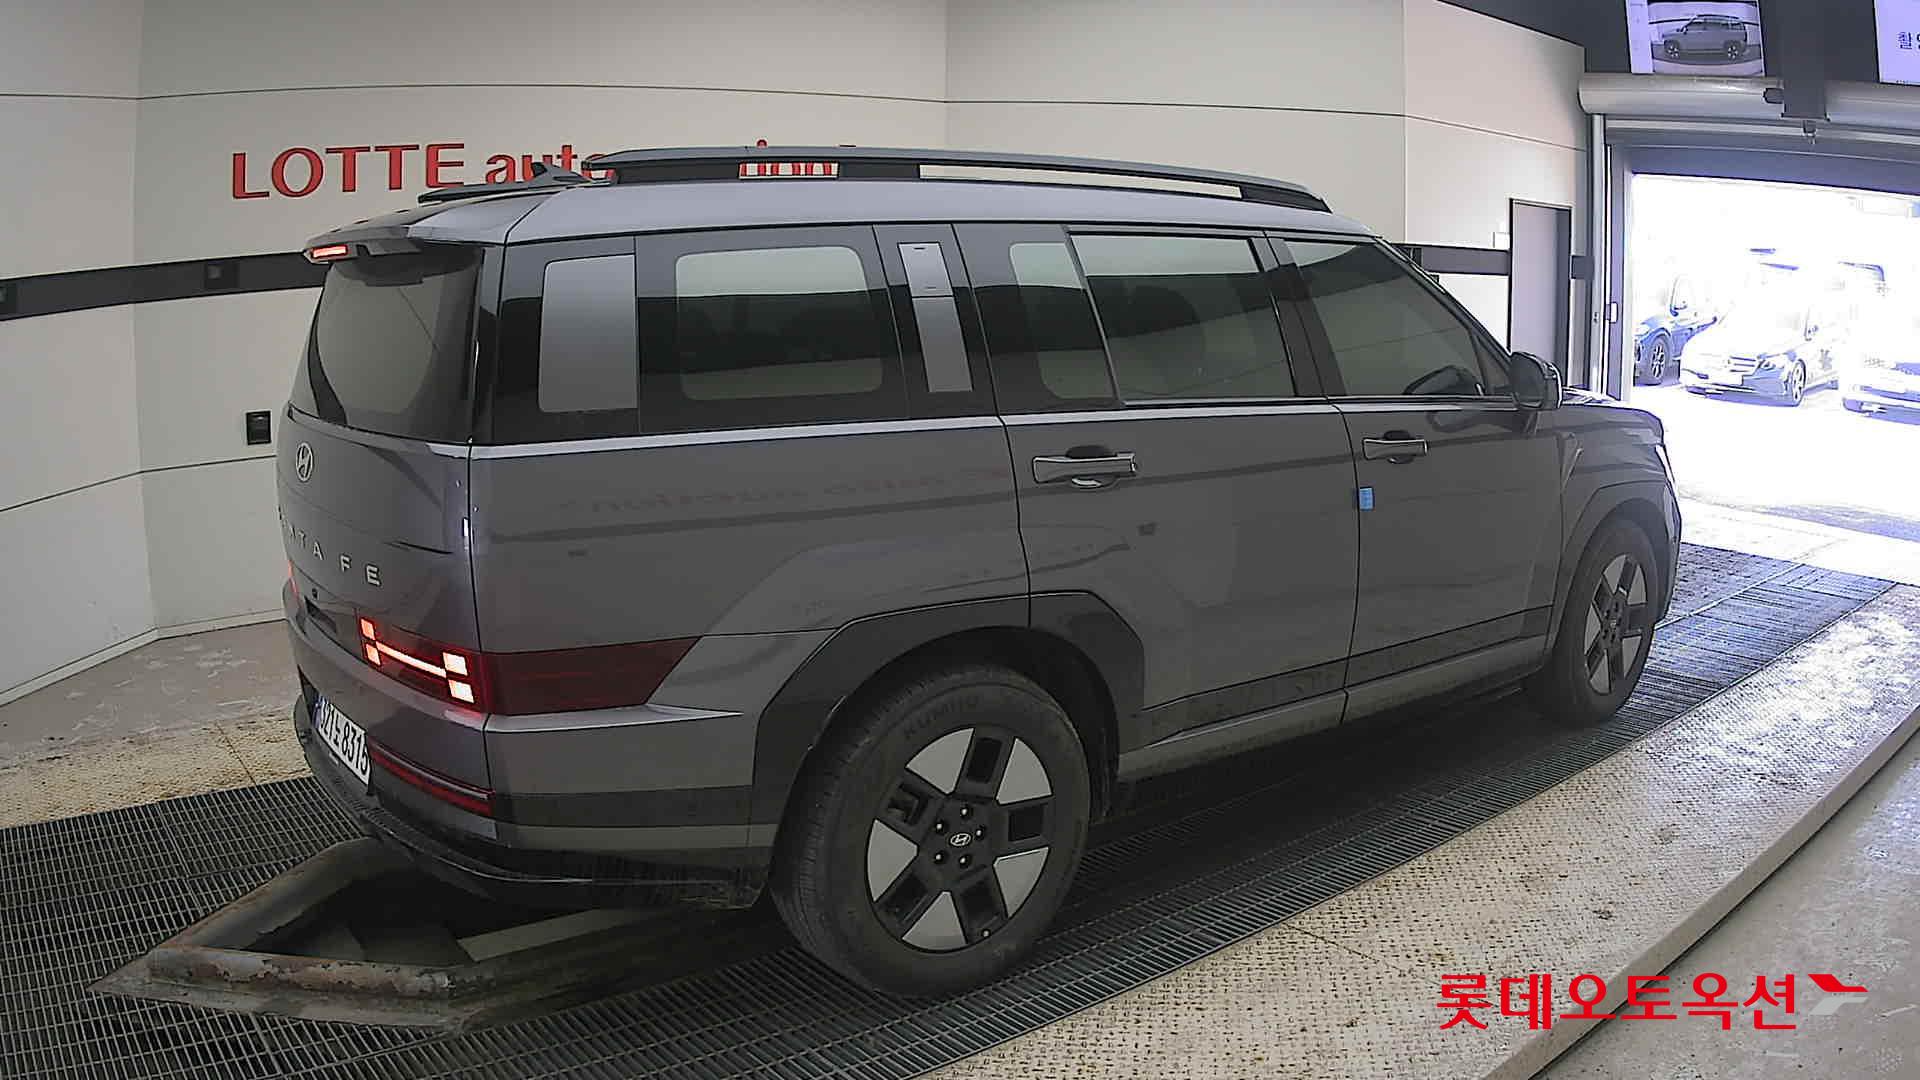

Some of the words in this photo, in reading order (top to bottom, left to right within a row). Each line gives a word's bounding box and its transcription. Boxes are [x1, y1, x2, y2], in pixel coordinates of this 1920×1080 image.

[233, 143, 464, 199] LOTTE
[340, 554, 382, 587] FE
[341, 721, 369, 776] 8315
